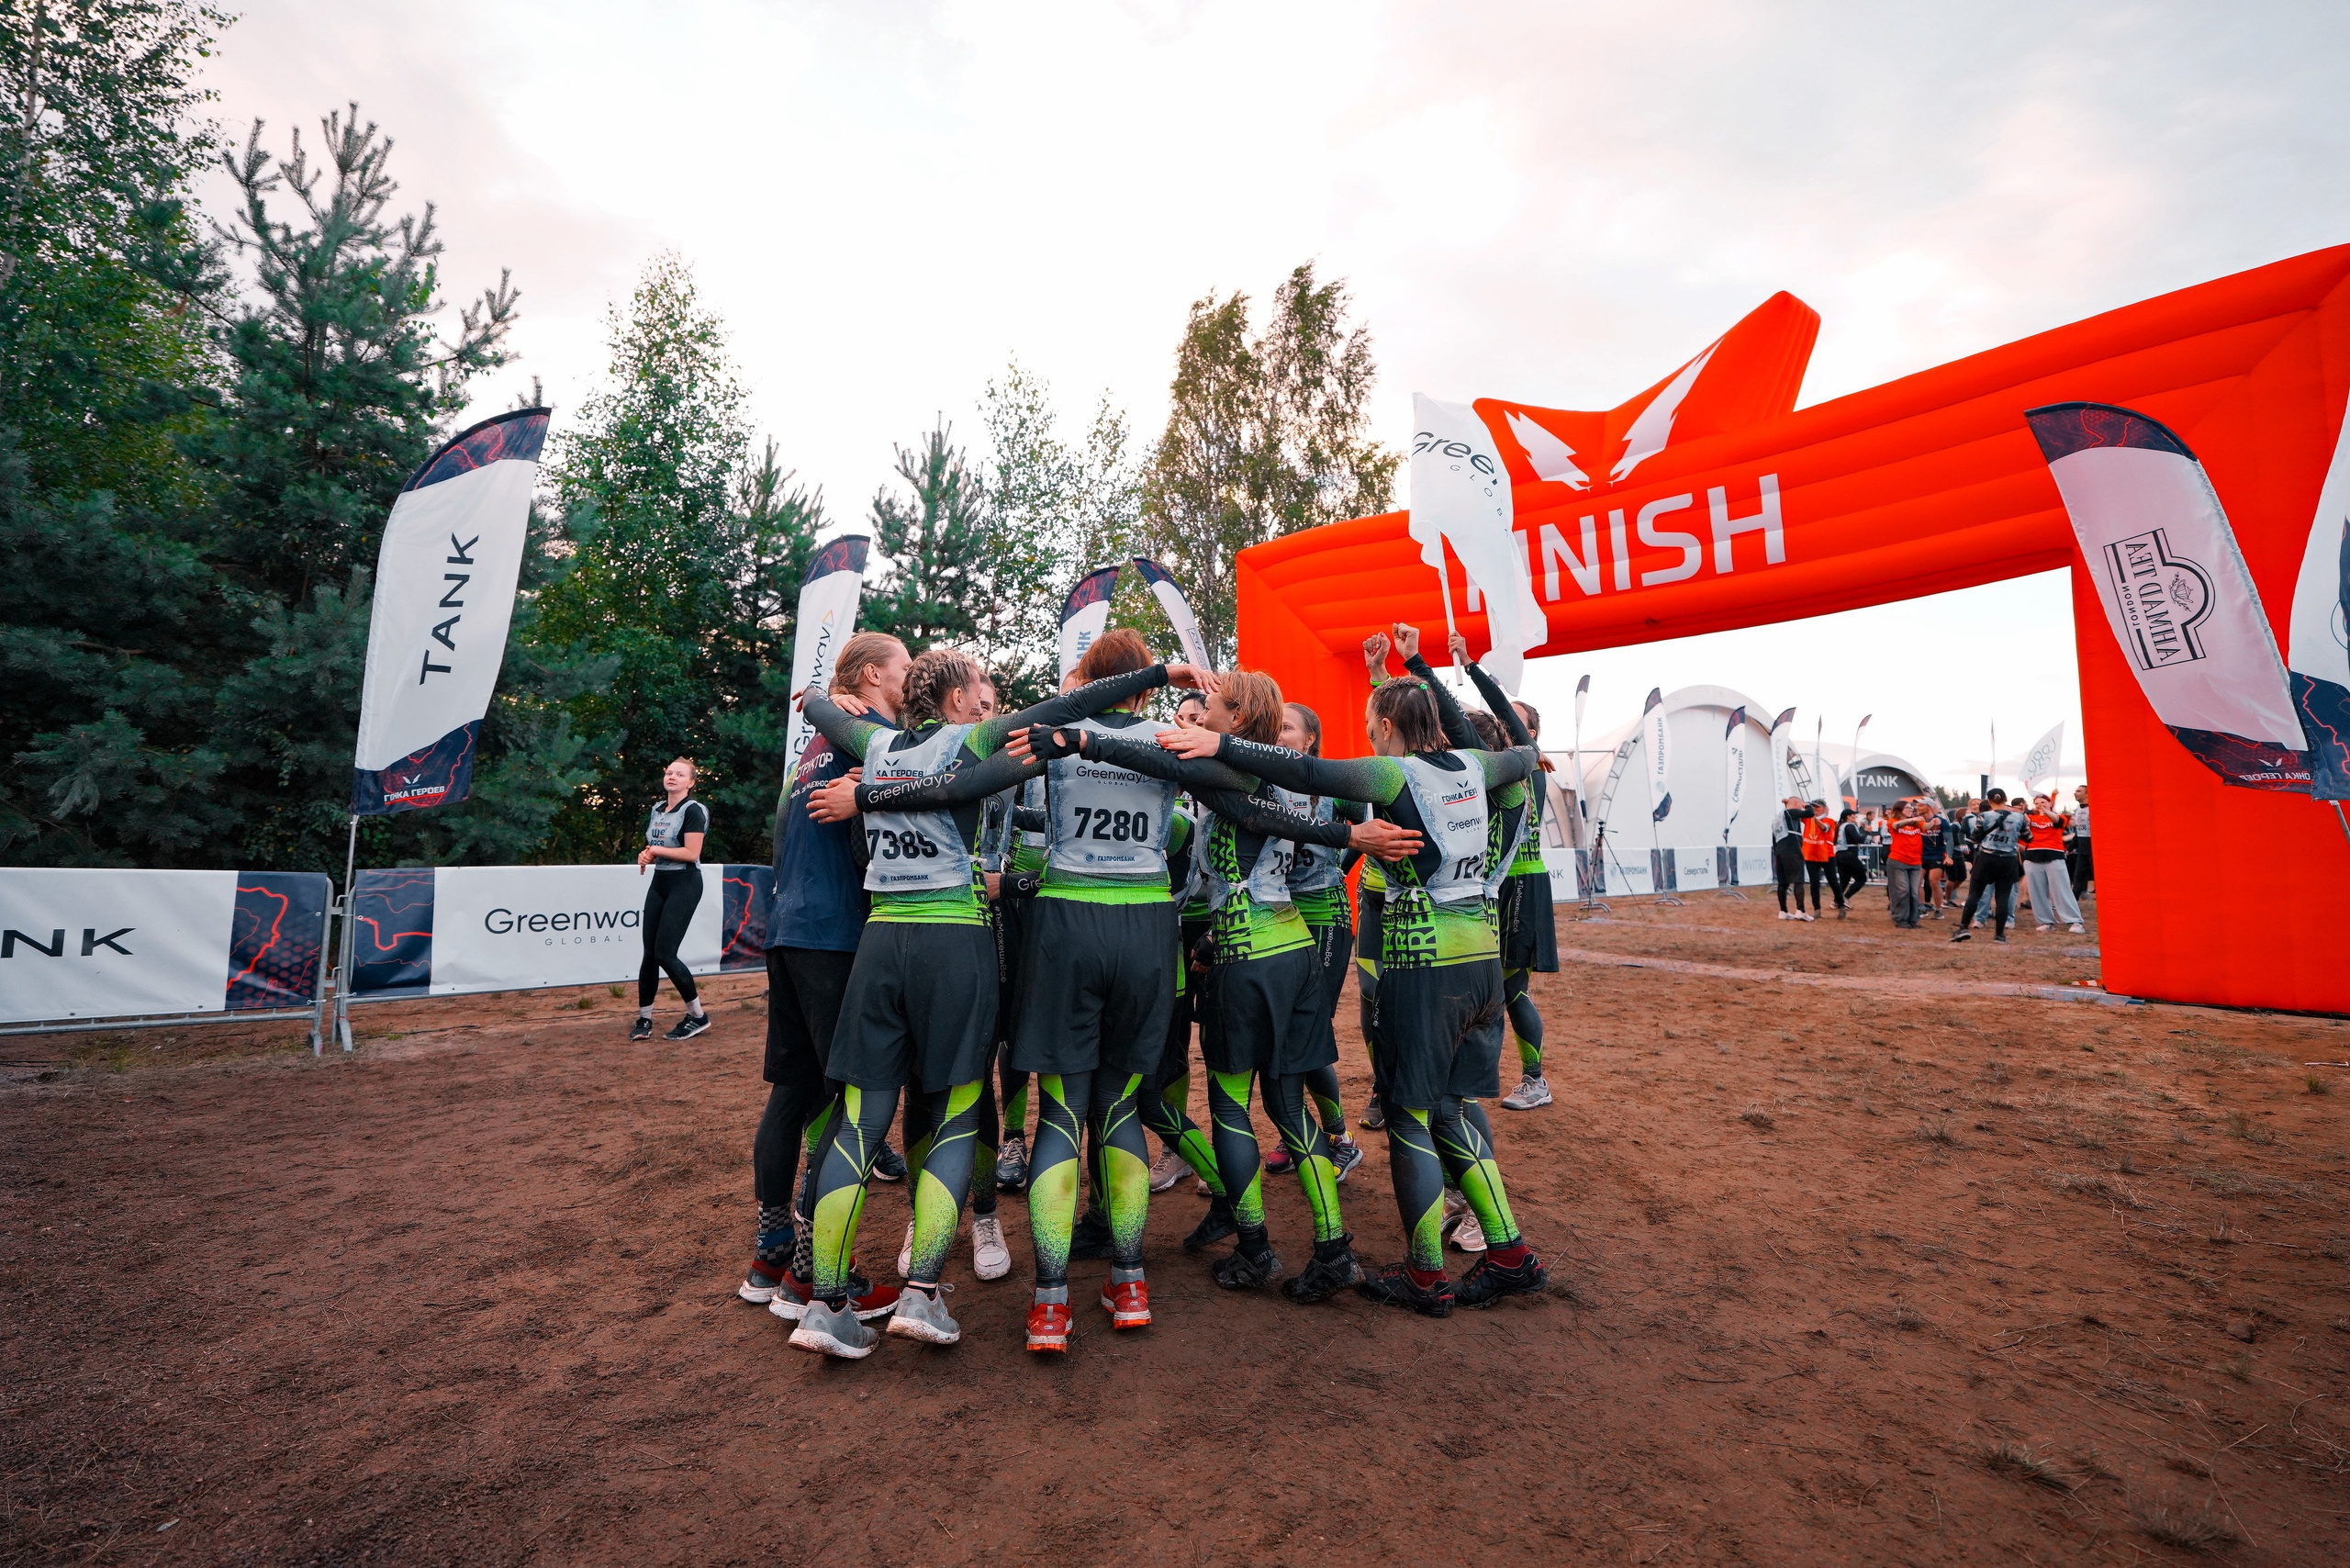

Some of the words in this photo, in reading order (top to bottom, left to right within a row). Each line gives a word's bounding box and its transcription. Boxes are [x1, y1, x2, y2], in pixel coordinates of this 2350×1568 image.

[1412, 431, 1498, 486] Gree
[1466, 473, 1786, 613] NISH
[419, 532, 479, 686] TANK
[890, 769, 924, 778] ГЕРОЕВ
[1076, 766, 1143, 784] Greenway
[1857, 775, 1898, 788] TANK
[411, 786, 445, 797] ГЕРОЕВ
[867, 774, 944, 804] Greenway
[1441, 792, 1464, 803] ГОНКА
[1248, 794, 1316, 826] Greenway
[1074, 806, 1149, 843] 7280
[867, 829, 939, 860] 7385
[1988, 834, 2009, 845] 7841
[485, 908, 644, 935] Greenwa
[1, 928, 137, 958] NK
[544, 935, 623, 946] GLOBAL
